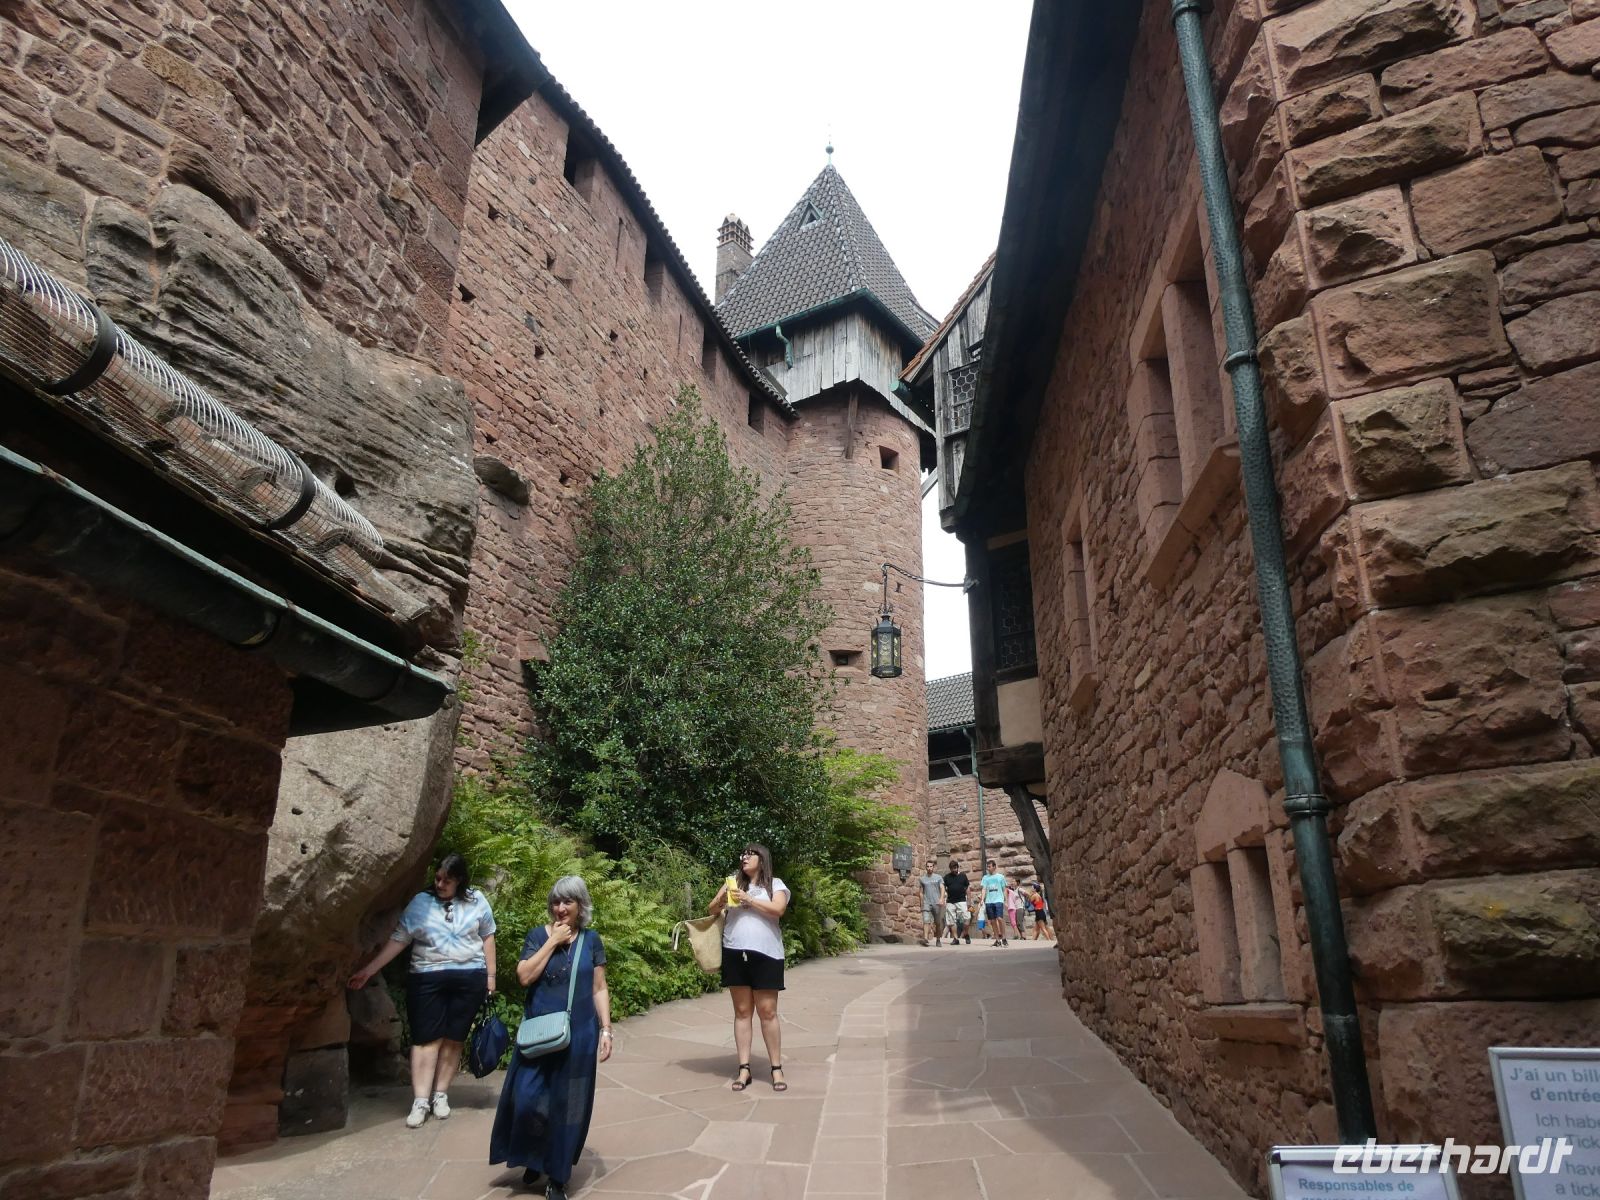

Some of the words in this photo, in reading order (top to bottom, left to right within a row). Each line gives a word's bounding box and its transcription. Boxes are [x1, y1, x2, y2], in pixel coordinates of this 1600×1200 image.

[1545, 1071, 1567, 1082] un
[1571, 1068, 1600, 1082] bill
[1536, 1113, 1560, 1127] Ich
[1563, 1133, 1600, 1149] Tick
[1297, 1178, 1393, 1192] Responsables
[1397, 1179, 1415, 1192] de
[1555, 1183, 1566, 1195] a
[1570, 1181, 1600, 1197] tick
